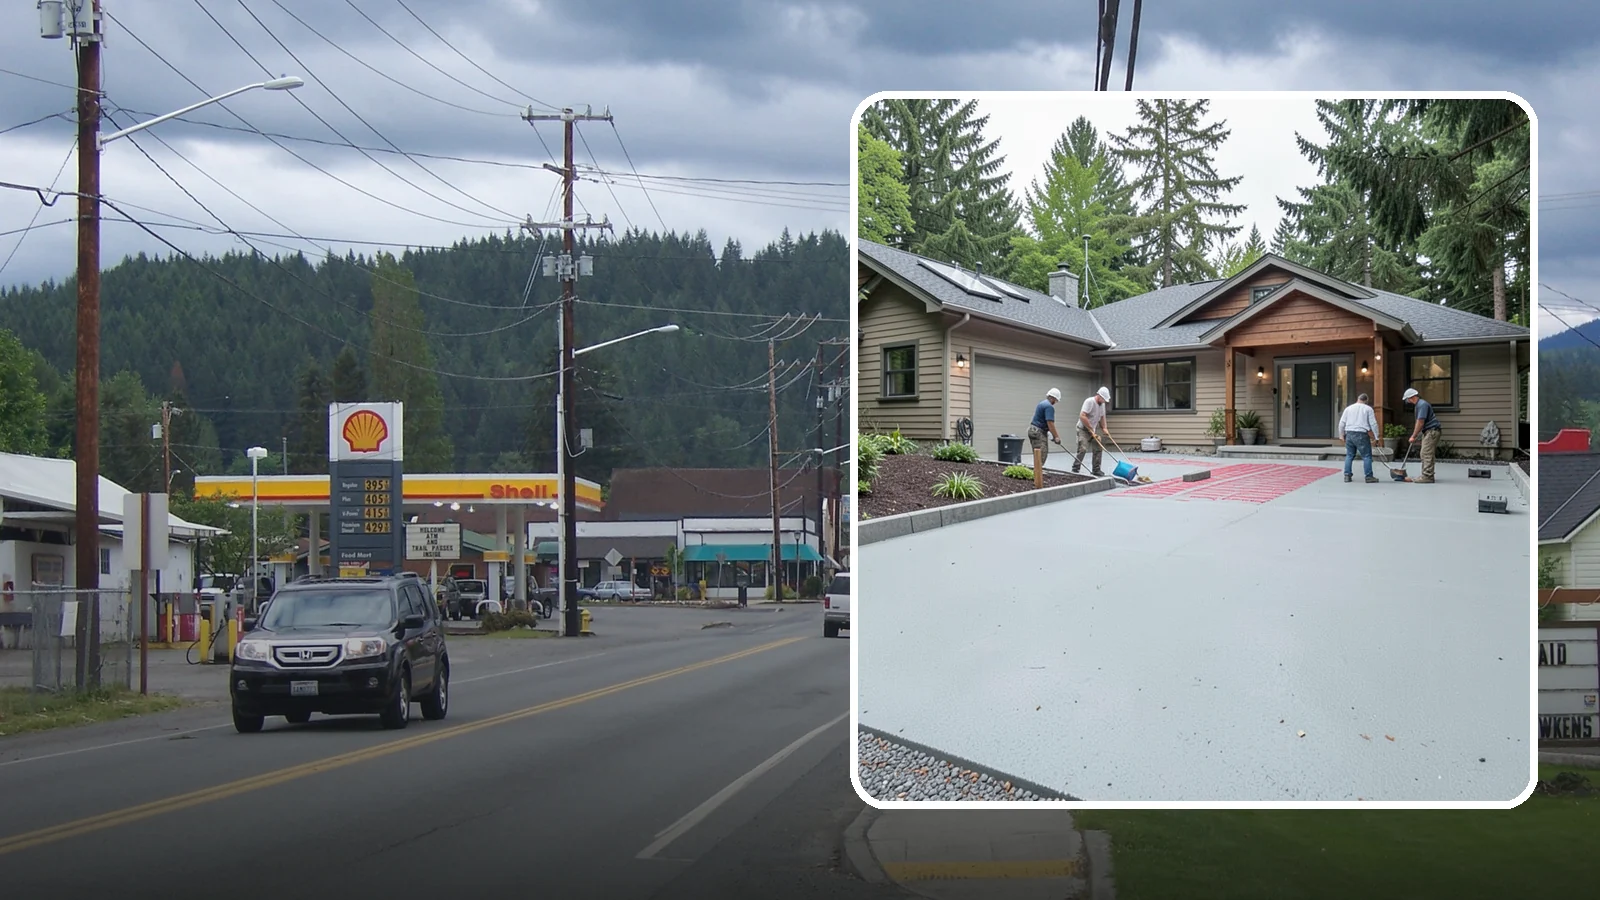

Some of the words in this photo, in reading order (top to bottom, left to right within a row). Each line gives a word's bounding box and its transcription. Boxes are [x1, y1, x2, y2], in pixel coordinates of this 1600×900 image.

[366, 480, 384, 490] 395
[490, 484, 547, 499] Shell
[365, 494, 384, 504] 405
[366, 508, 384, 518] 415
[365, 522, 384, 533] 429
[1538, 642, 1567, 665] AID
[1538, 715, 1592, 739] WKENS
